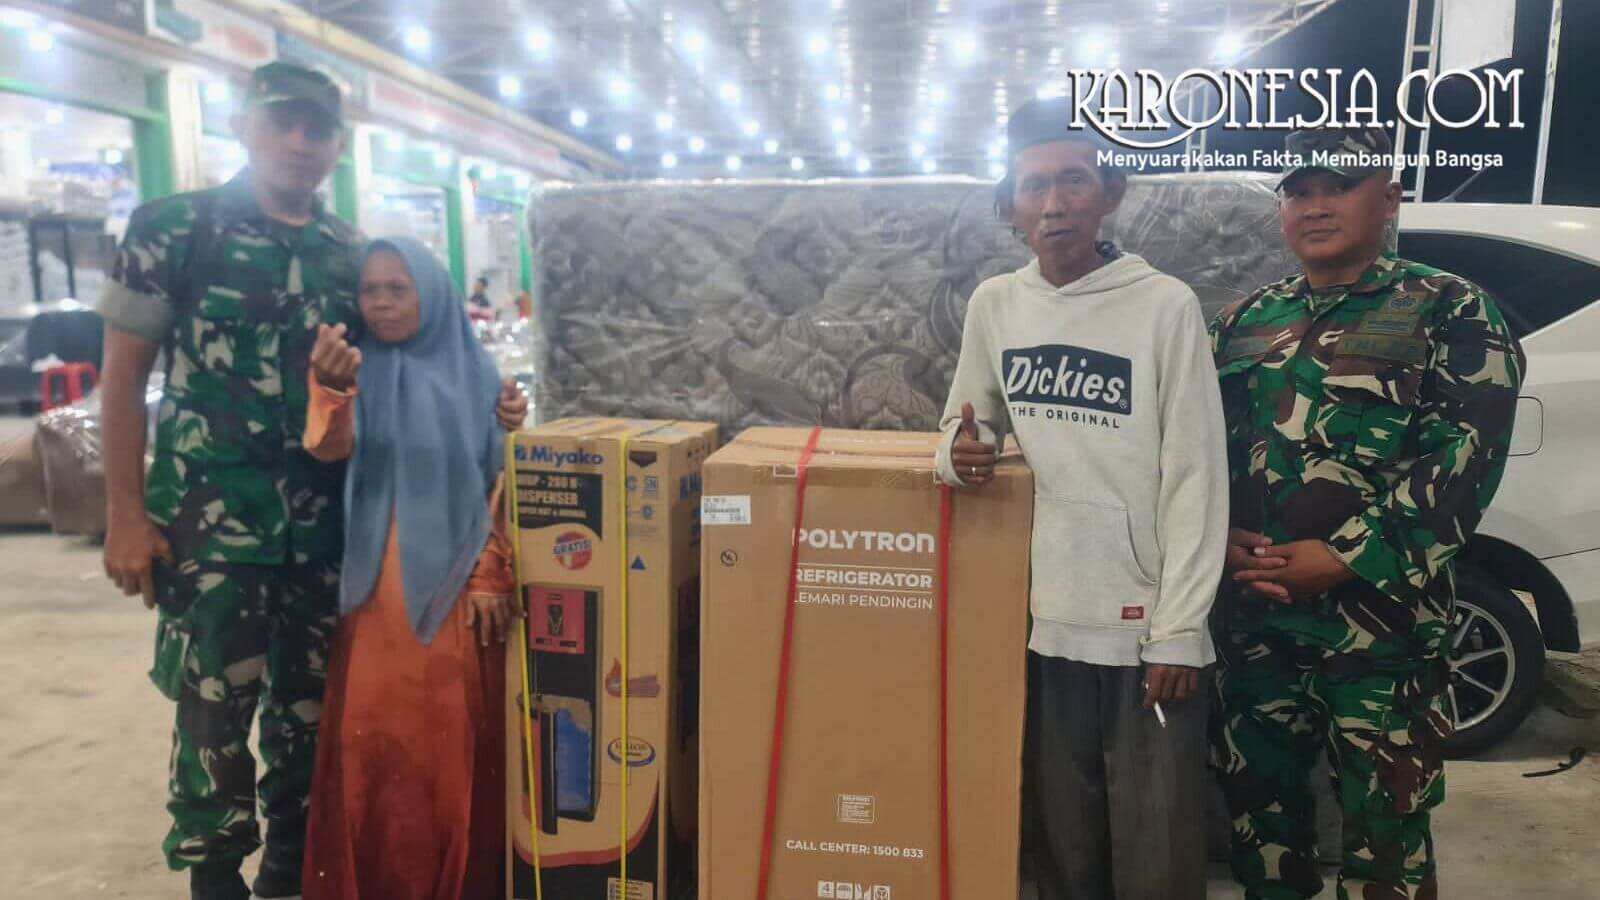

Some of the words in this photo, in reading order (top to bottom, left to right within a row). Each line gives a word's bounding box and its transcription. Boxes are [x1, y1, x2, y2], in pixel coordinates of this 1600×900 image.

[1007, 355, 1125, 404] Dickies
[1012, 407, 1036, 417] THE
[1046, 409, 1120, 429] ORIGINAL
[531, 446, 603, 467] Miyako
[794, 591, 846, 606] EMARI
[849, 594, 933, 610] PENDINGIN
[786, 839, 817, 851] CALL
[819, 842, 870, 855] CENTER:
[873, 846, 900, 857] 1500
[902, 848, 924, 859] 833
